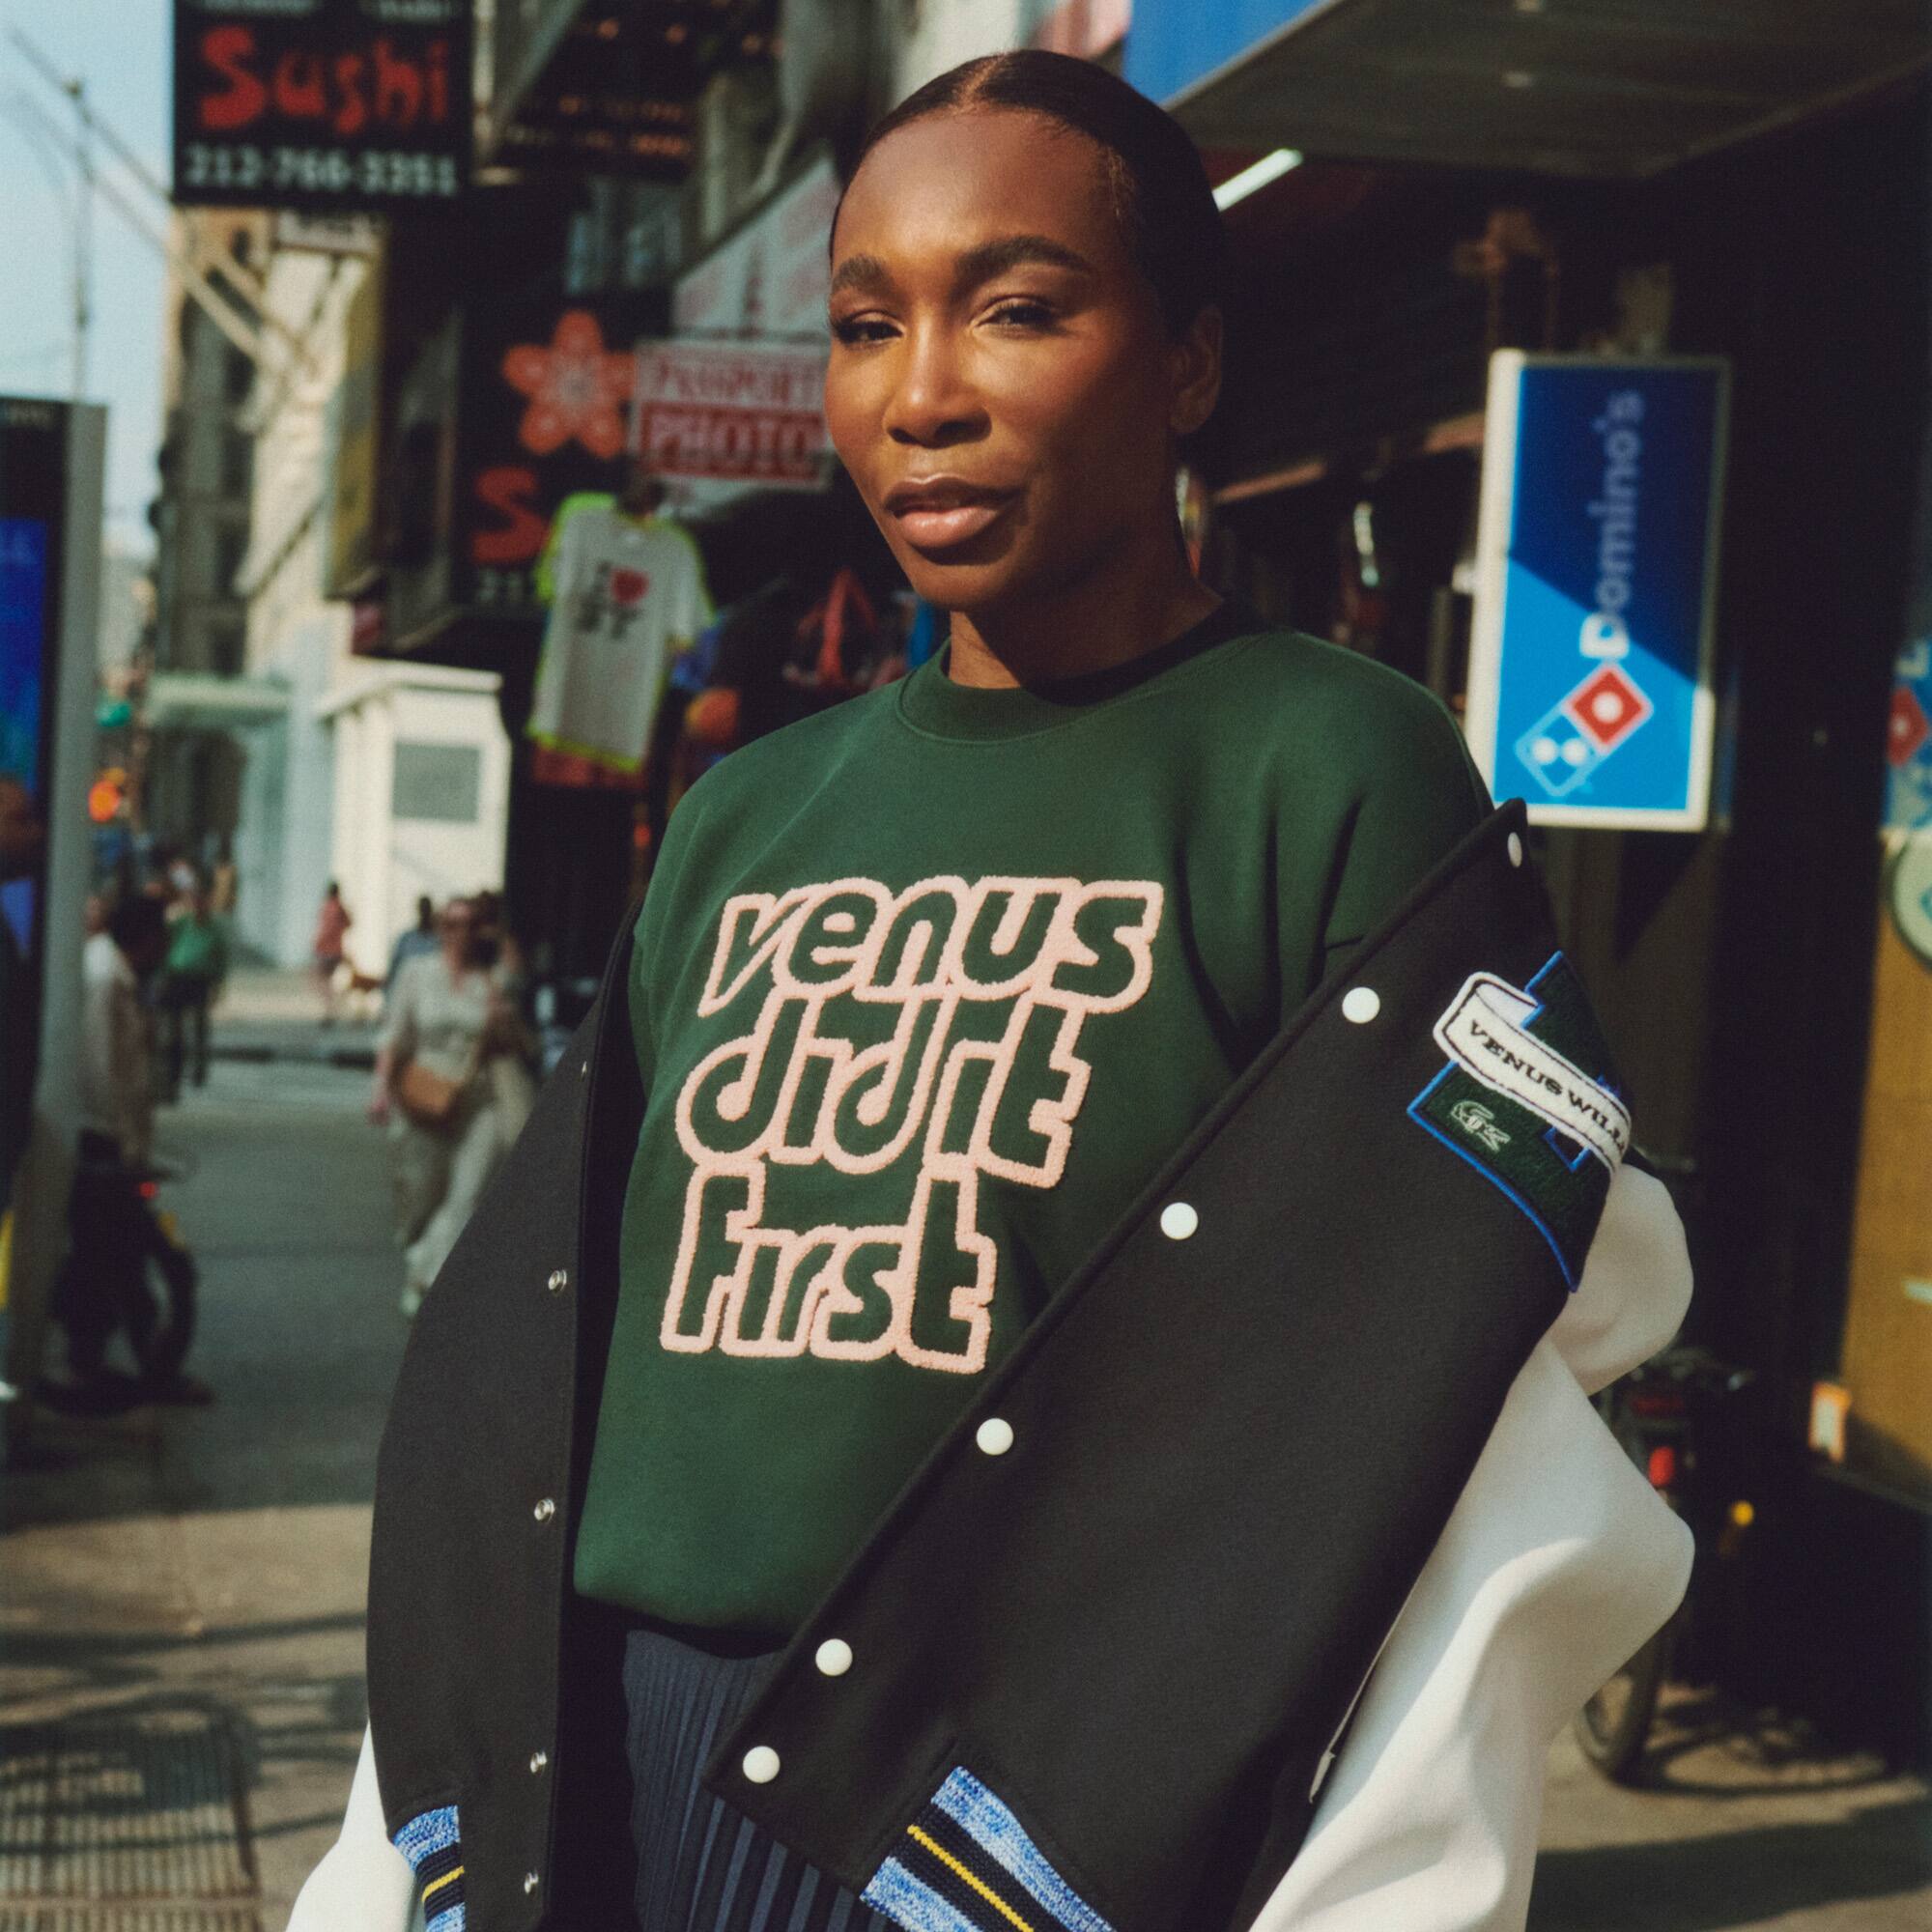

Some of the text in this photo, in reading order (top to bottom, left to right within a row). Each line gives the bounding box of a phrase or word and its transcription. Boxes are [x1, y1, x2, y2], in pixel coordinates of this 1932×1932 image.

[201, 27, 449, 133] Sushi
[649, 412, 823, 473] PHOTO
[1579, 388, 1644, 659] Domino's
[697, 875, 1163, 1016] venus
[674, 983, 1092, 1188] did it
[1469, 1019, 1563, 1095] VENUS
[660, 1157, 997, 1374] first
